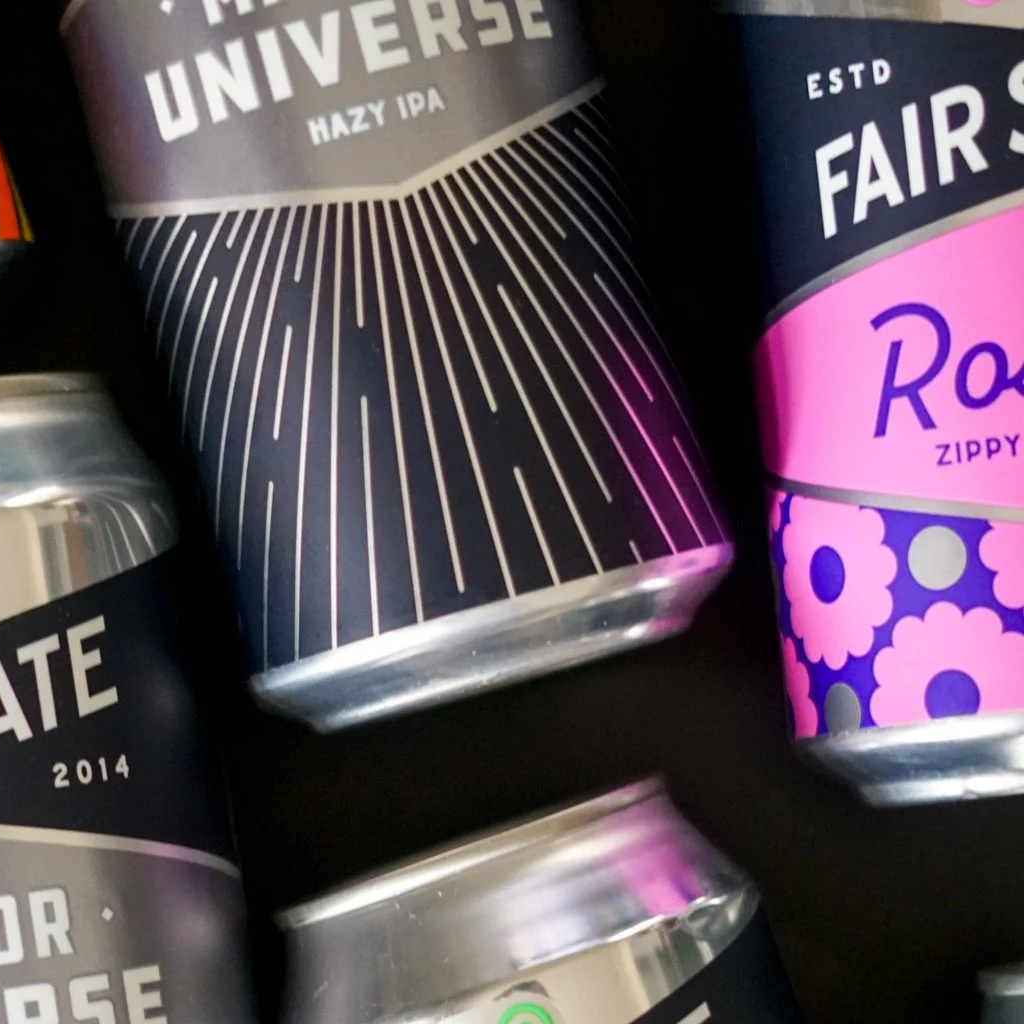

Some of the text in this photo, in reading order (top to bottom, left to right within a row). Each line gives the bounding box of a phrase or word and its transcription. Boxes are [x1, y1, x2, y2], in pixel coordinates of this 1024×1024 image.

[144, 0, 553, 142] UNIVERSE
[806, 58, 892, 100] ESTD
[307, 87, 446, 146] HAZY IPA
[814, 84, 989, 240] FAIR
[870, 302, 1024, 439] Ro
[935, 433, 1020, 467] ZIPPY
[52, 754, 131, 788] 2014
